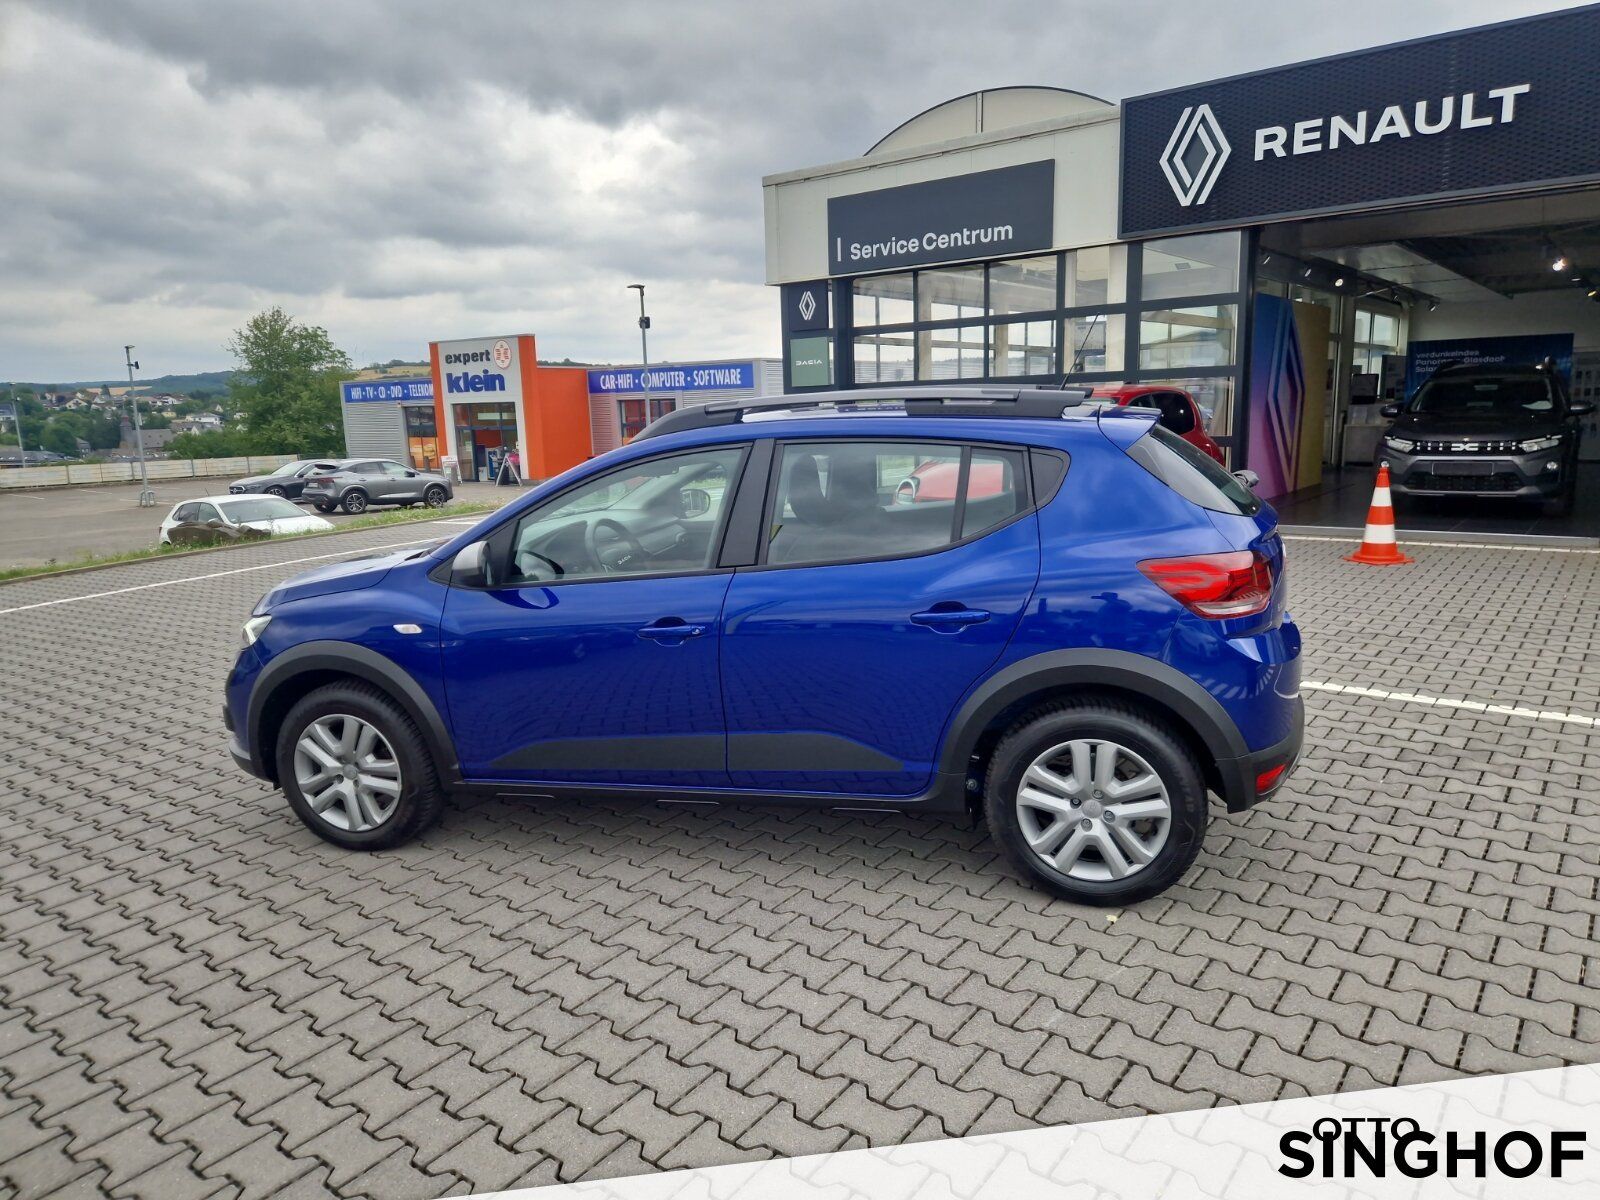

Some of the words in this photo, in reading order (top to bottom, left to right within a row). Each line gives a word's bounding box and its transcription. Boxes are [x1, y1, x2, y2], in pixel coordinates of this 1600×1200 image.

[1254, 84, 1530, 161] RENAULT
[850, 236, 919, 260] Service
[922, 224, 1013, 251] Centrum
[445, 349, 491, 365] expert
[446, 368, 506, 393] klein
[600, 374, 633, 390] CAR-HIFI
[693, 368, 742, 386] SOFTWARE
[365, 386, 374, 399] TV
[390, 385, 403, 398] DVD
